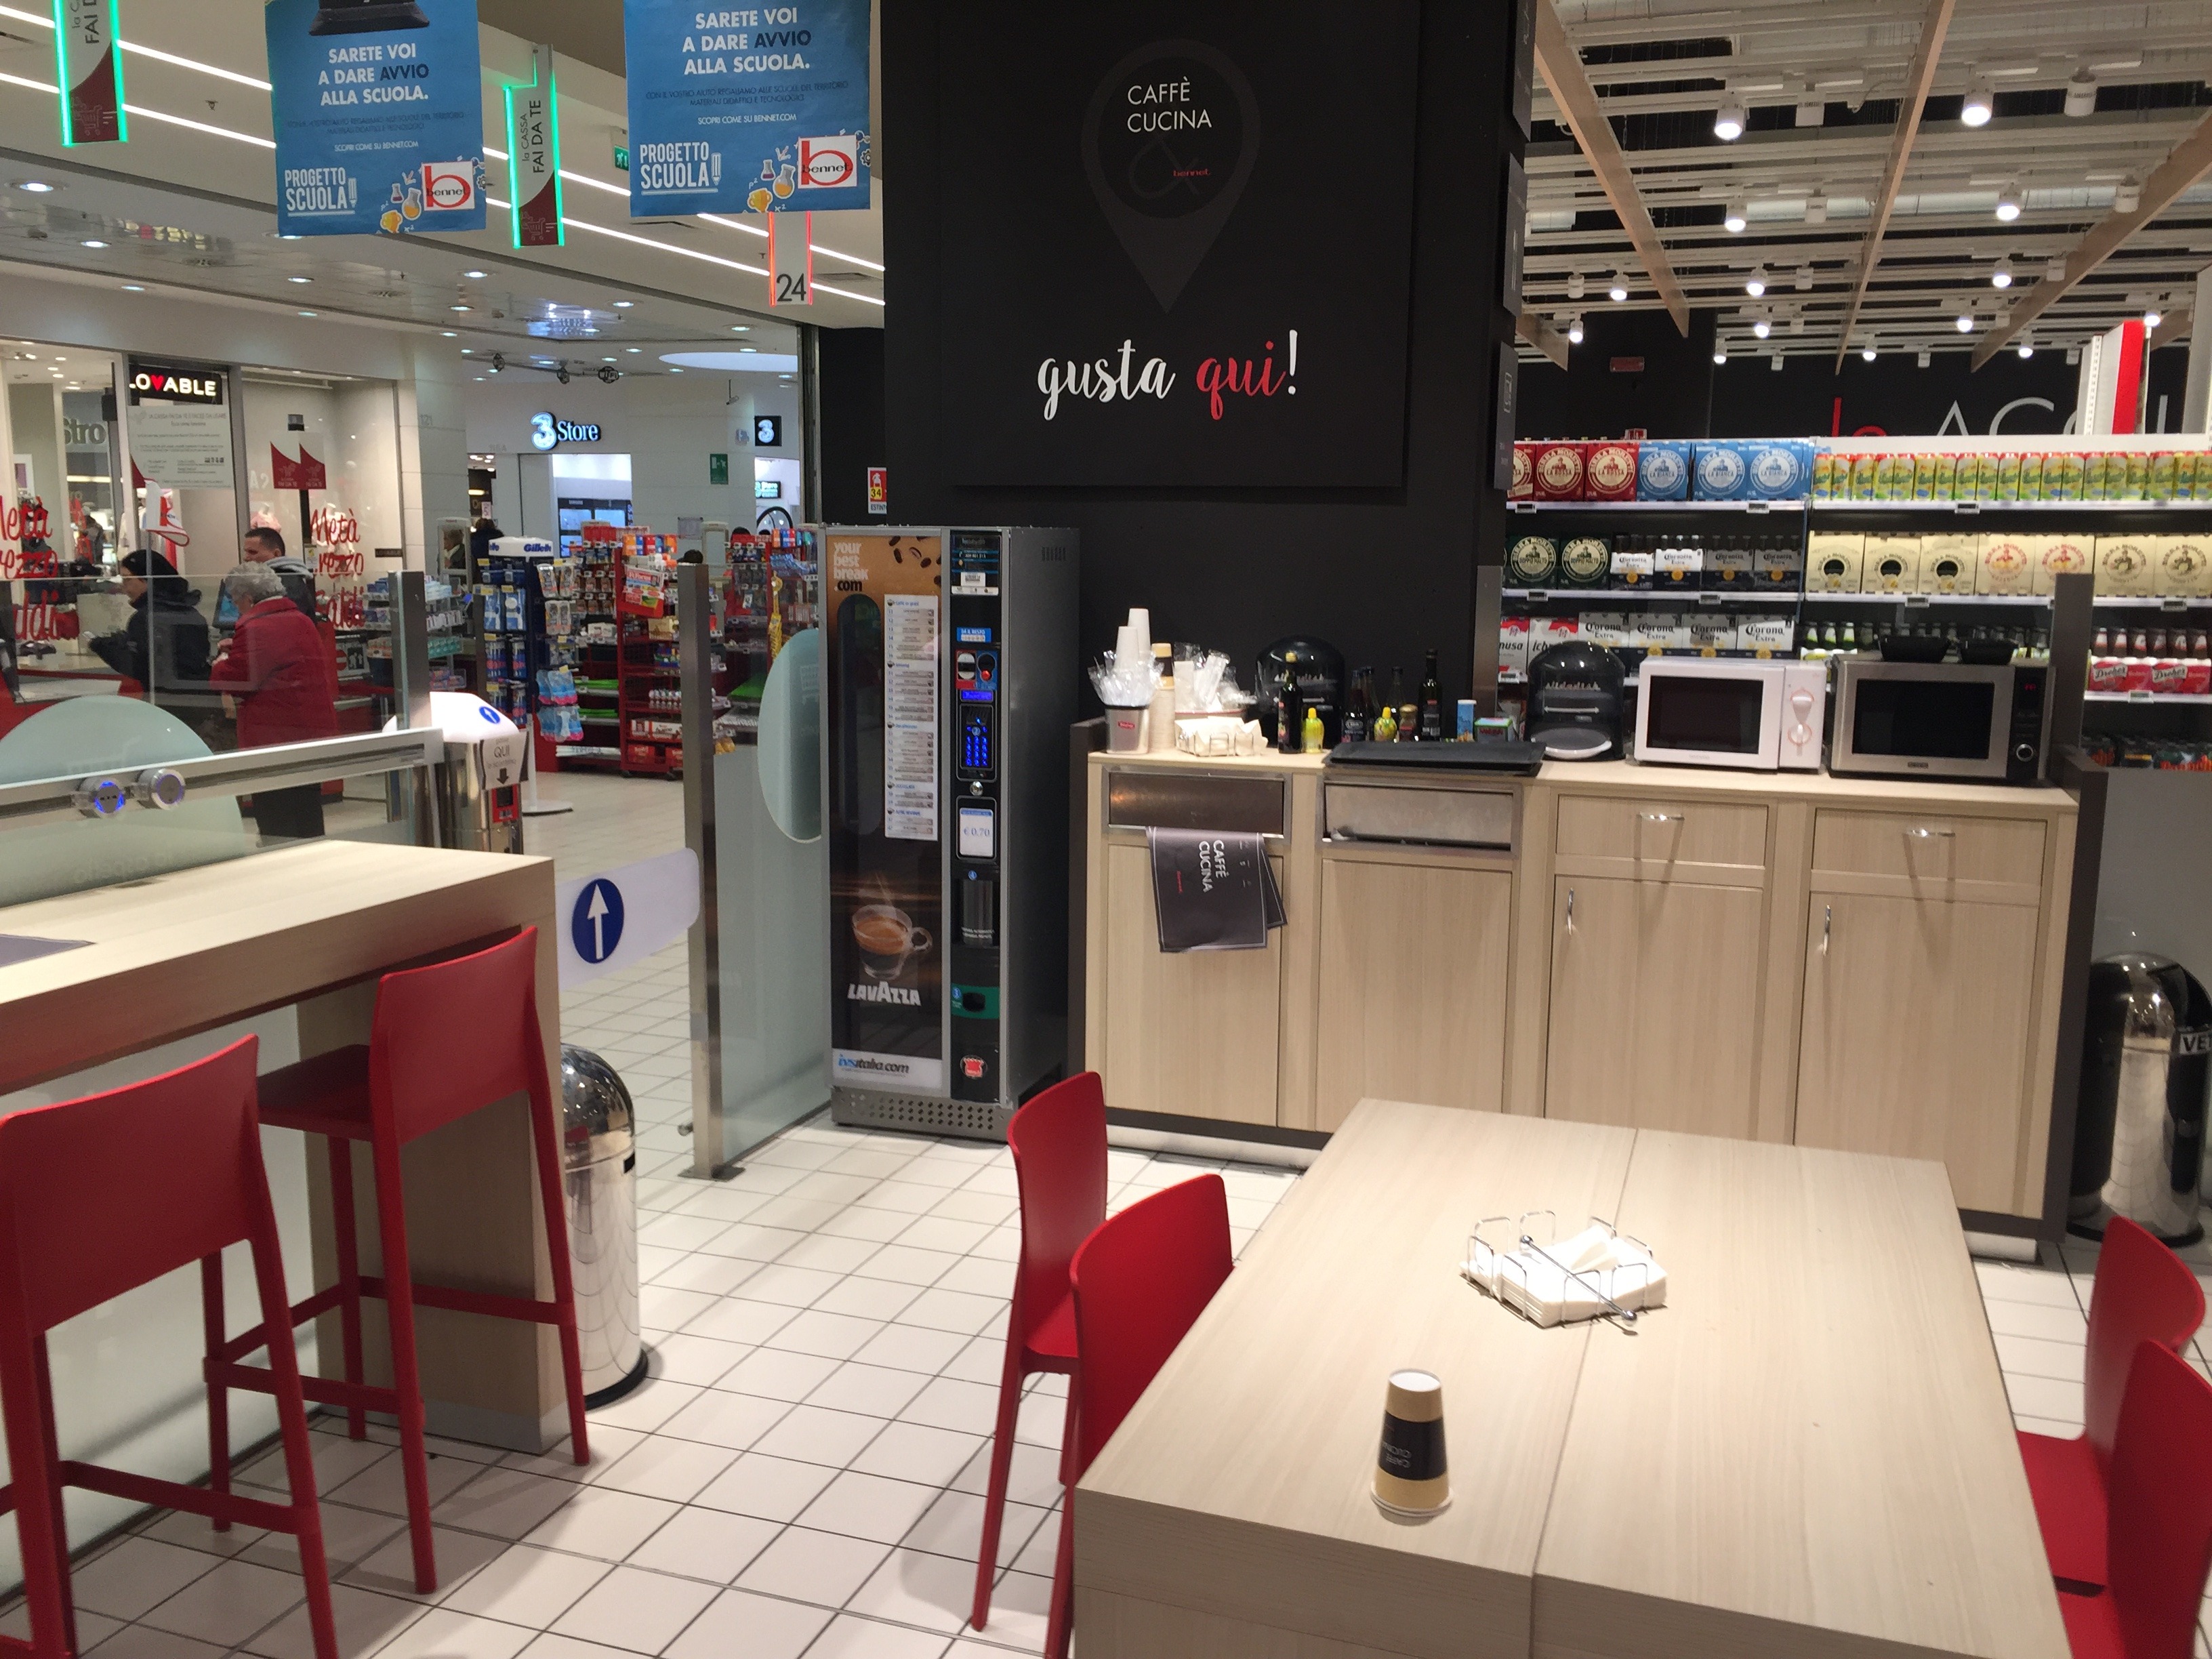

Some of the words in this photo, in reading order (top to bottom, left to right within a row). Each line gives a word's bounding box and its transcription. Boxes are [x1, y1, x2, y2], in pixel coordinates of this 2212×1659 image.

[695, 10, 758, 29] SARETE
[764, 7, 797, 24] VOI
[84, 15, 100, 43] FAI
[682, 37, 695, 52] A
[701, 34, 747, 52] DARE
[754, 30, 812, 49] AVVIO
[329, 45, 383, 64] SARETE
[387, 43, 416, 60] VOI
[318, 70, 329, 85] A
[334, 68, 375, 85] DARE
[380, 64, 430, 81] AVVIO
[684, 58, 727, 75] ALLA
[733, 54, 811, 73] SCUOLA.
[320, 90, 359, 106] ALLA
[363, 85, 428, 104] SCUOLA.
[1128, 76, 1190, 105] CAFFÈ
[529, 100, 541, 117] TE
[698, 117, 720, 125] SCOPRI
[722, 116, 741, 124] COME
[754, 114, 796, 122] BENNET.COM
[1127, 109, 1212, 133] CUCINA
[520, 113, 529, 149] CASSA
[531, 121, 543, 145] DA
[522, 152, 530, 161] la
[533, 151, 544, 173] FAI
[640, 142, 710, 163] PROGETTO
[285, 167, 346, 187] PROGETTO
[776, 273, 806, 302] 24
[1038, 339, 1176, 420] gusta
[1196, 329, 1298, 420] qui!
[531, 411, 557, 451] 3
[557, 420, 598, 441] Store
[871, 488, 881, 498] 34
[310, 507, 361, 546] Metà
[834, 542, 862, 556] your
[834, 556, 860, 567] best
[1586, 621, 1621, 632] Corona
[1637, 622, 1675, 634] Corona
[1690, 623, 1728, 634] Corona
[1745, 623, 1784, 636] Corona
[1700, 633, 1720, 642] Extra
[2095, 665, 2127, 678] Dreher
[2154, 668, 2186, 679] Dreher
[1199, 841, 1213, 893] CUCINA
[1213, 840, 1230, 879] CAFFÈ
[847, 981, 922, 1000] LAVAZZA
